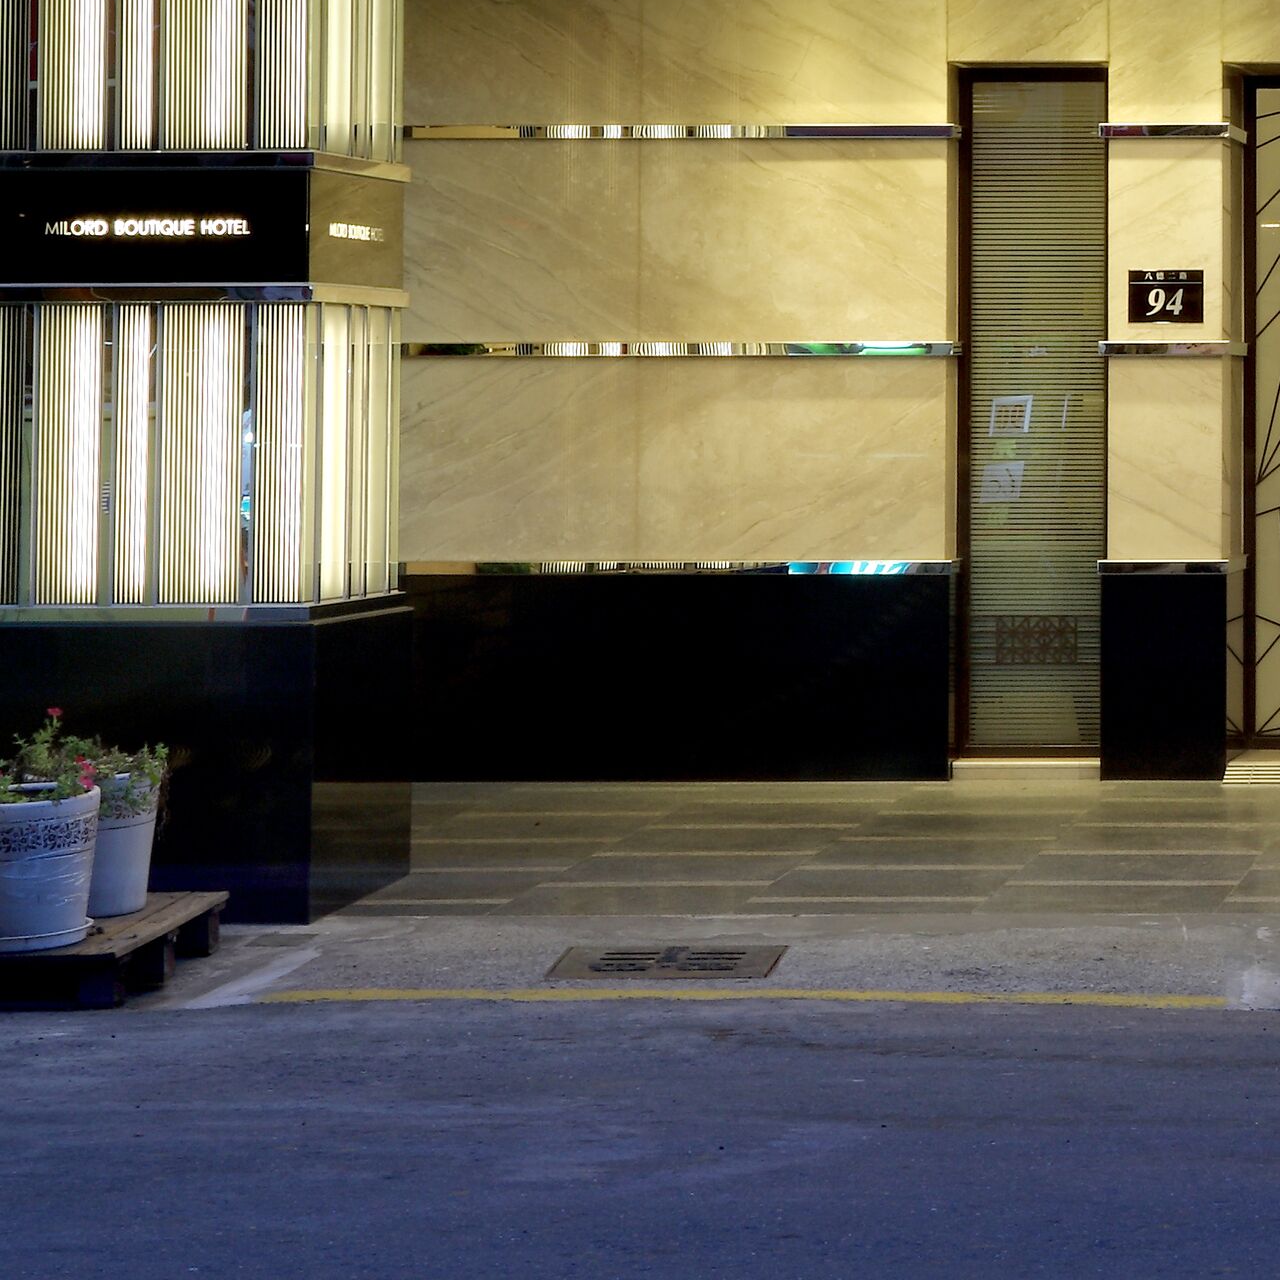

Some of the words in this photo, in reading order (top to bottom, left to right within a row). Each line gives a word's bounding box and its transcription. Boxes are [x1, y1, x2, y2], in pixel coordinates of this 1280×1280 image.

[44, 219, 108, 237] MILORD
[113, 218, 196, 237] BOUTIQUE
[200, 219, 251, 236] HOTEL
[1145, 288, 1184, 317] 94
